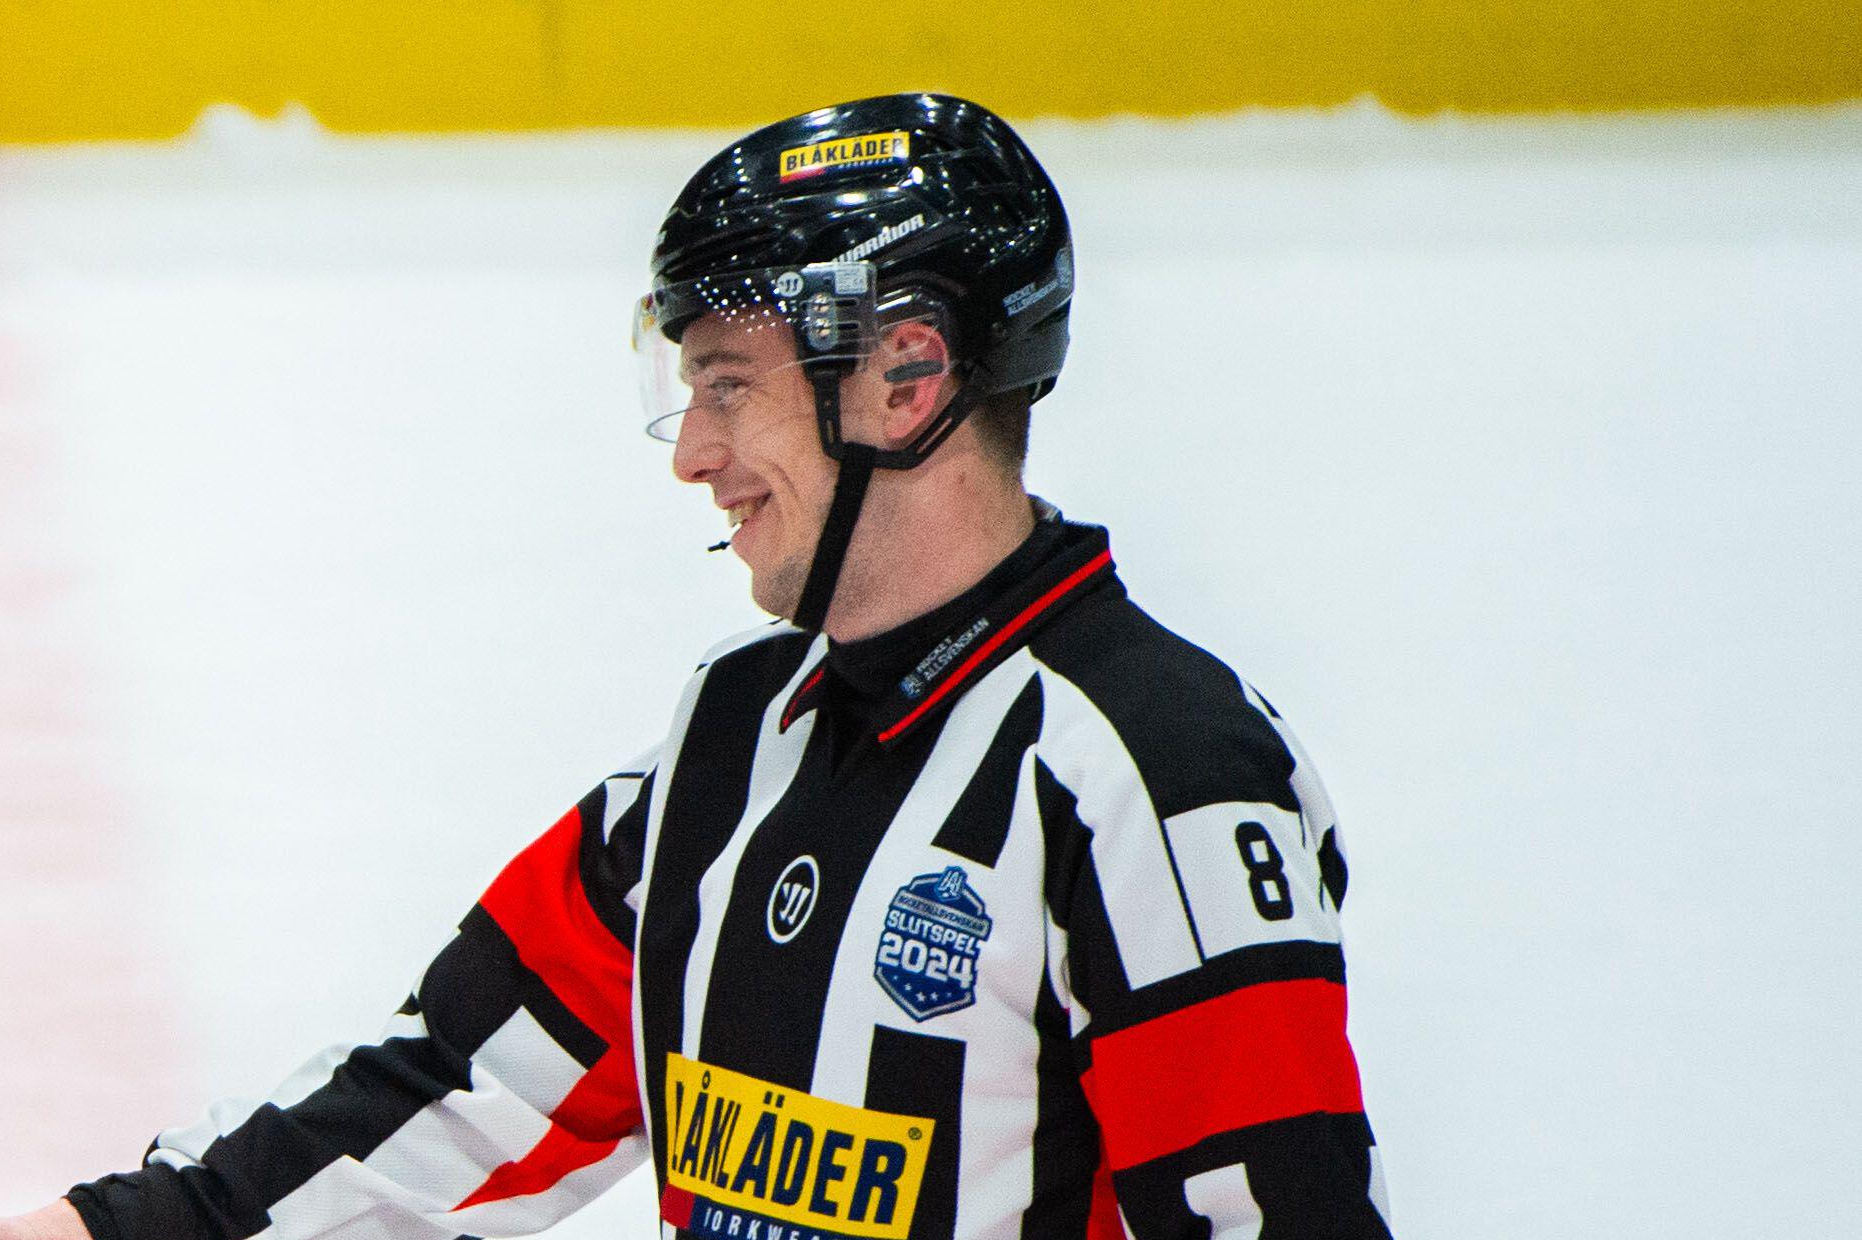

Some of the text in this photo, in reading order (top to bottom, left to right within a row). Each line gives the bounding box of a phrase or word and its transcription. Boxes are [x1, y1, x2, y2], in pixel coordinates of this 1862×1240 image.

[1234, 821, 1294, 921] 8
[878, 931, 974, 989] 2024
[886, 909, 977, 955] SLUTSPEL
[671, 1070, 908, 1226] LÅKLÄDER
